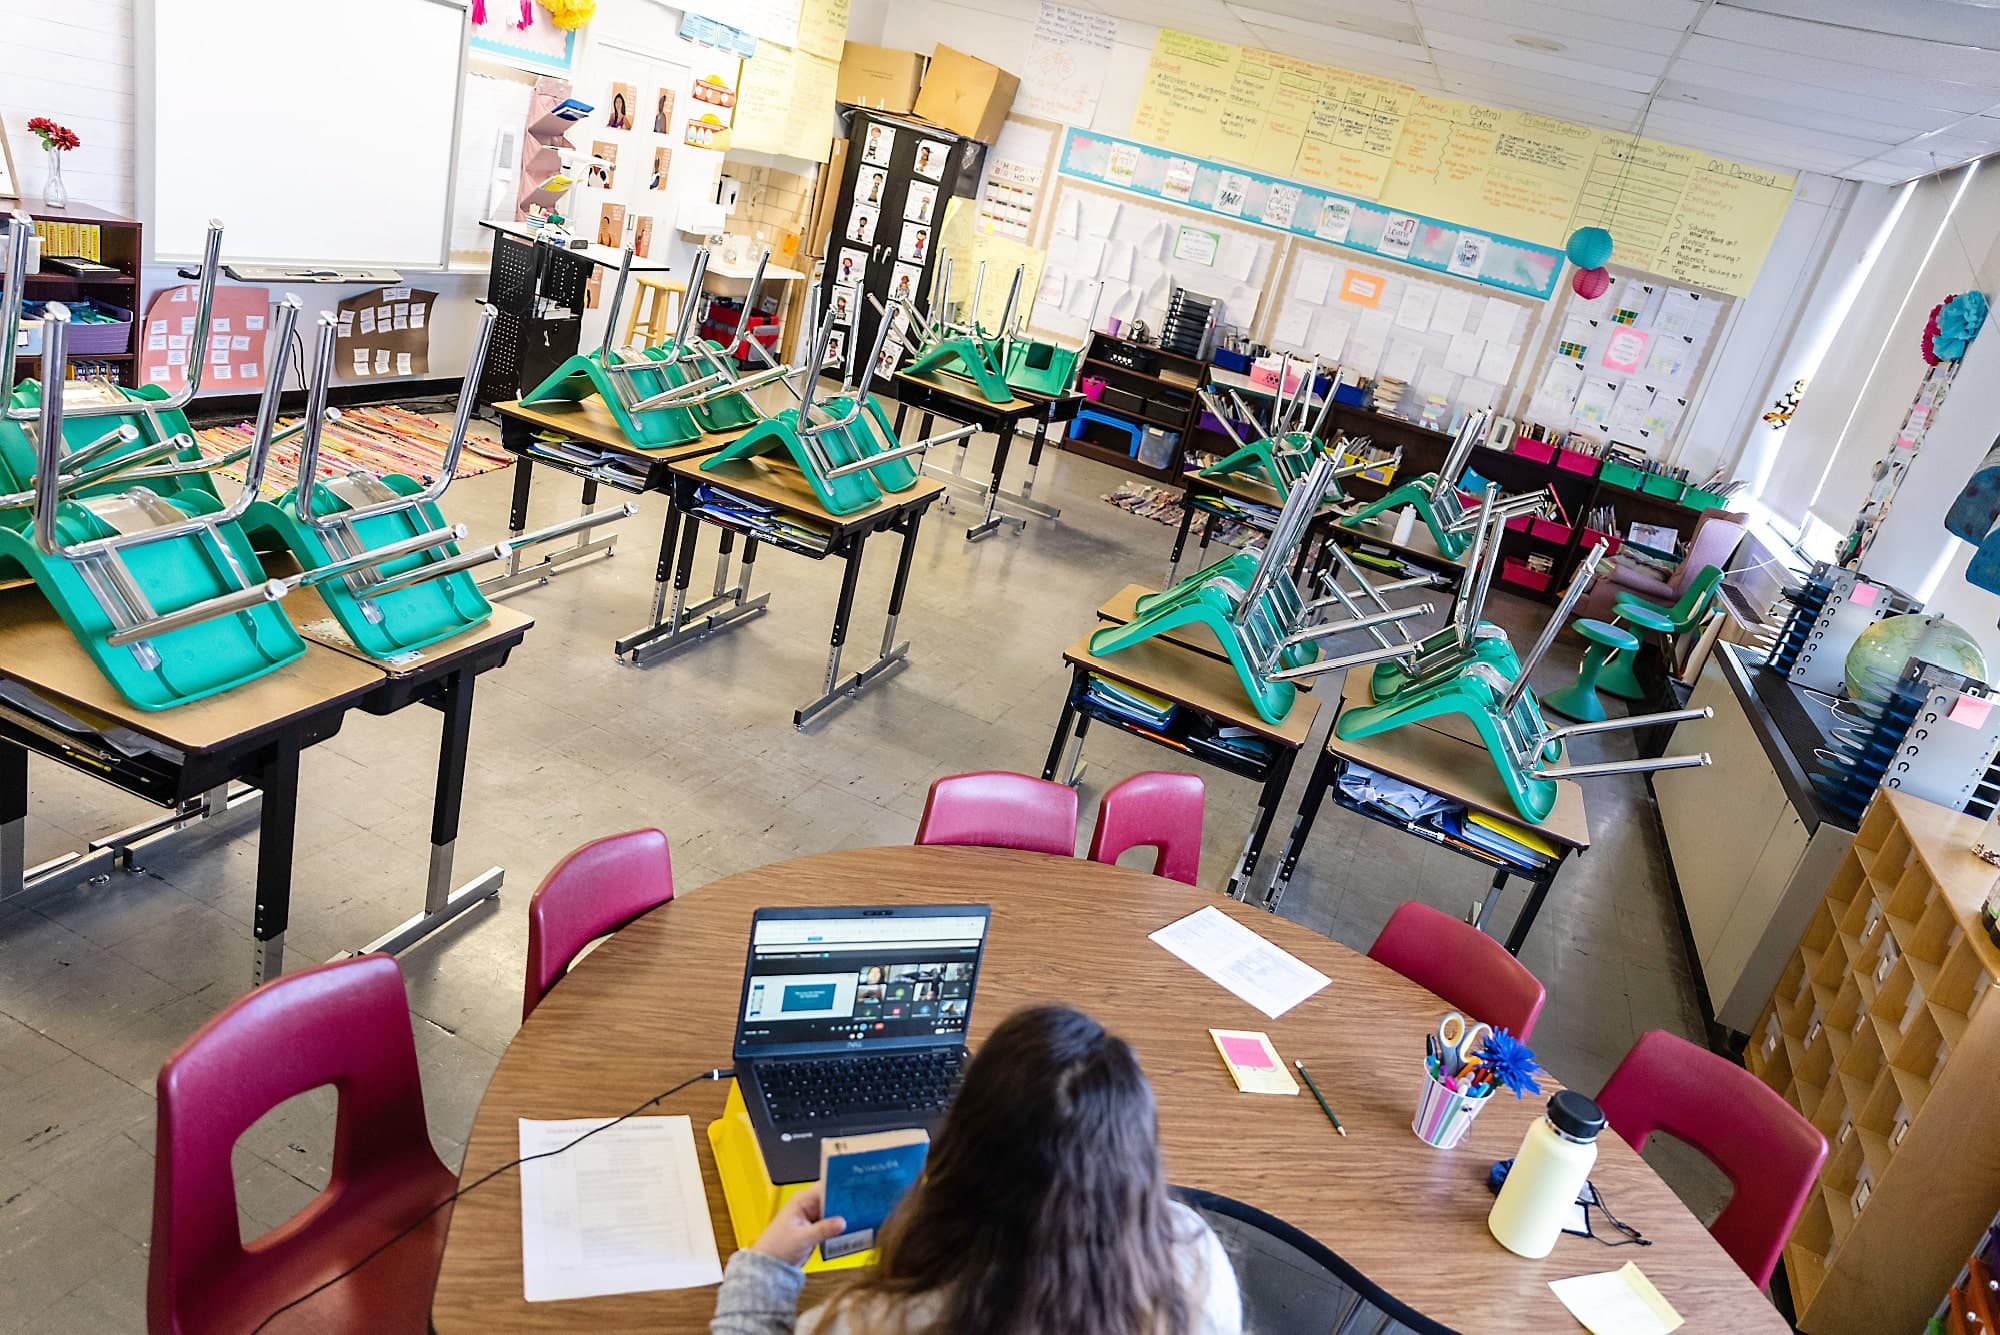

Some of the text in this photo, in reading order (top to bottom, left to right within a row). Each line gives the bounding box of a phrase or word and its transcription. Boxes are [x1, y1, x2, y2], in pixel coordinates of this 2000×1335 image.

[1415, 95, 1448, 113] Theme
[1469, 105, 1502, 120] Central
[1471, 117, 1493, 129] Idea
[1707, 159, 1776, 185] On Demand
[1674, 214, 1685, 230] S
[1669, 232, 1680, 244] P
[1661, 246, 1705, 264] A Audience
